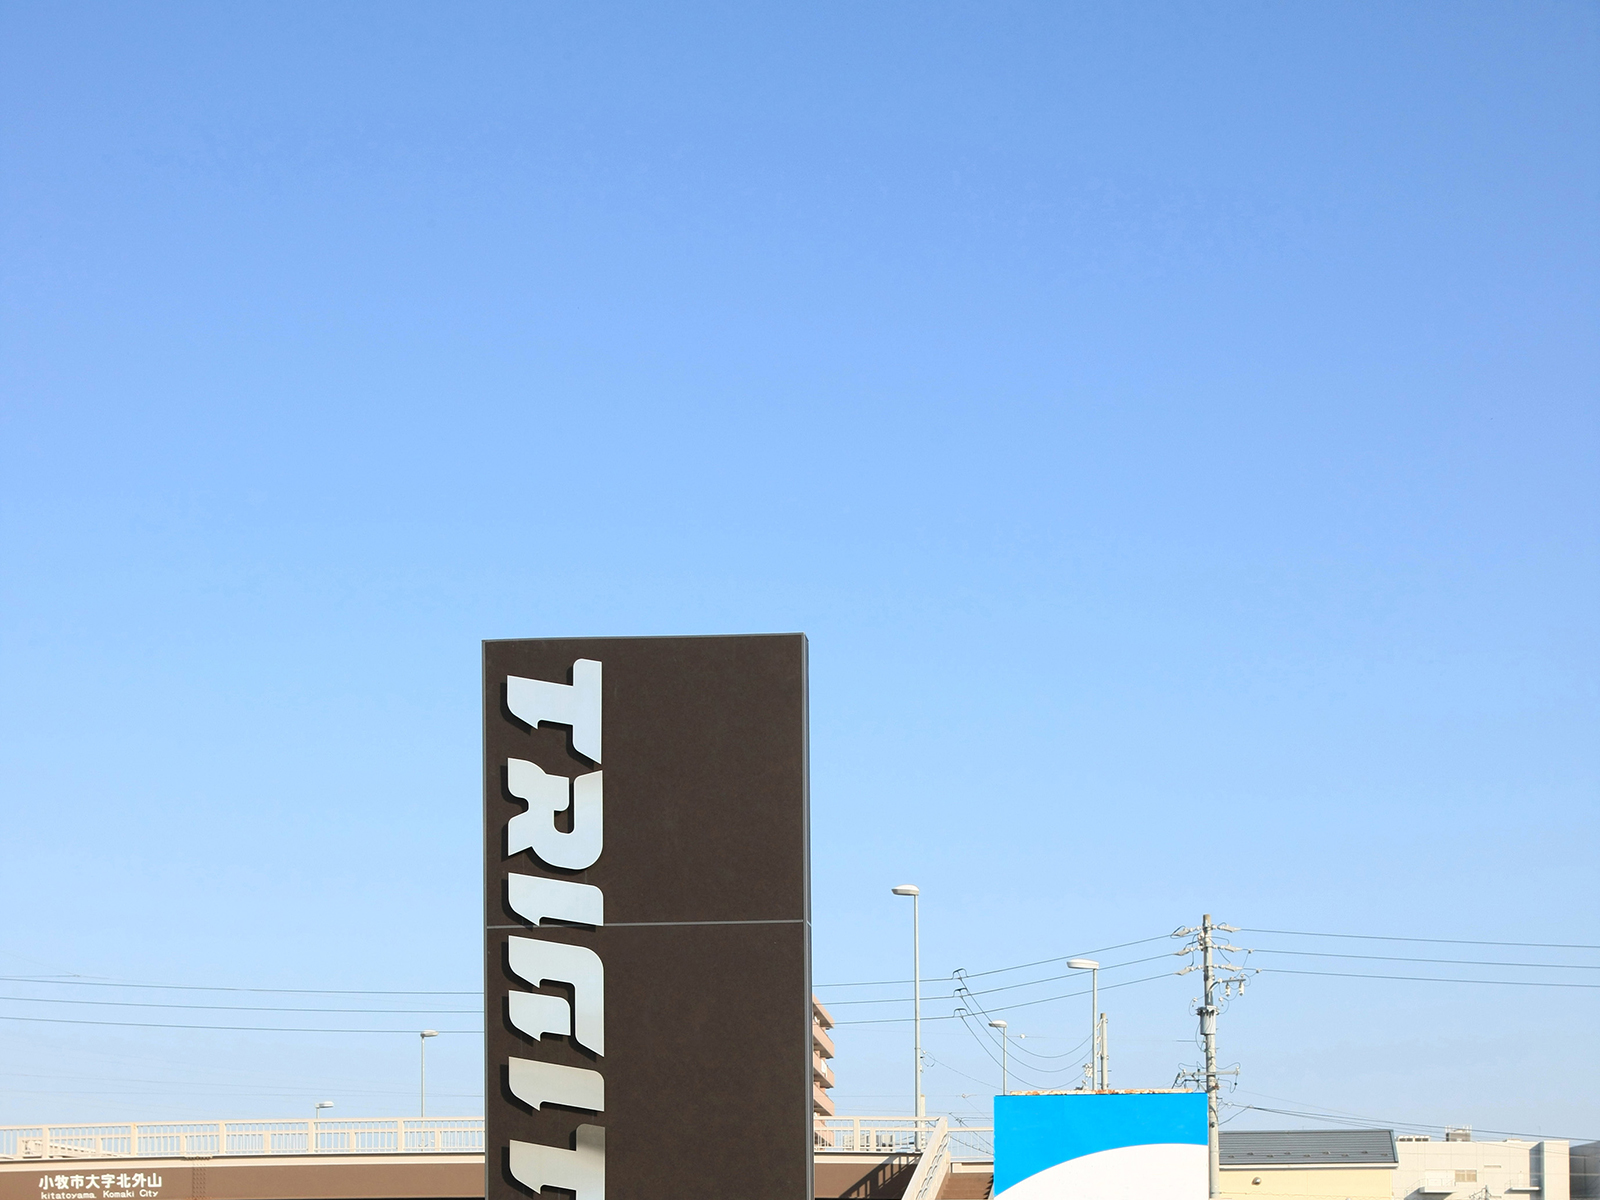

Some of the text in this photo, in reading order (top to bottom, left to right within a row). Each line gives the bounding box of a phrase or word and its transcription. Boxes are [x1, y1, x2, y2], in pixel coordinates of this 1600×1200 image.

[38, 1173, 163, 1190] 小牧市大字北外山
[102, 1189, 135, 1199] Komaki
[139, 1188, 159, 1198] City
